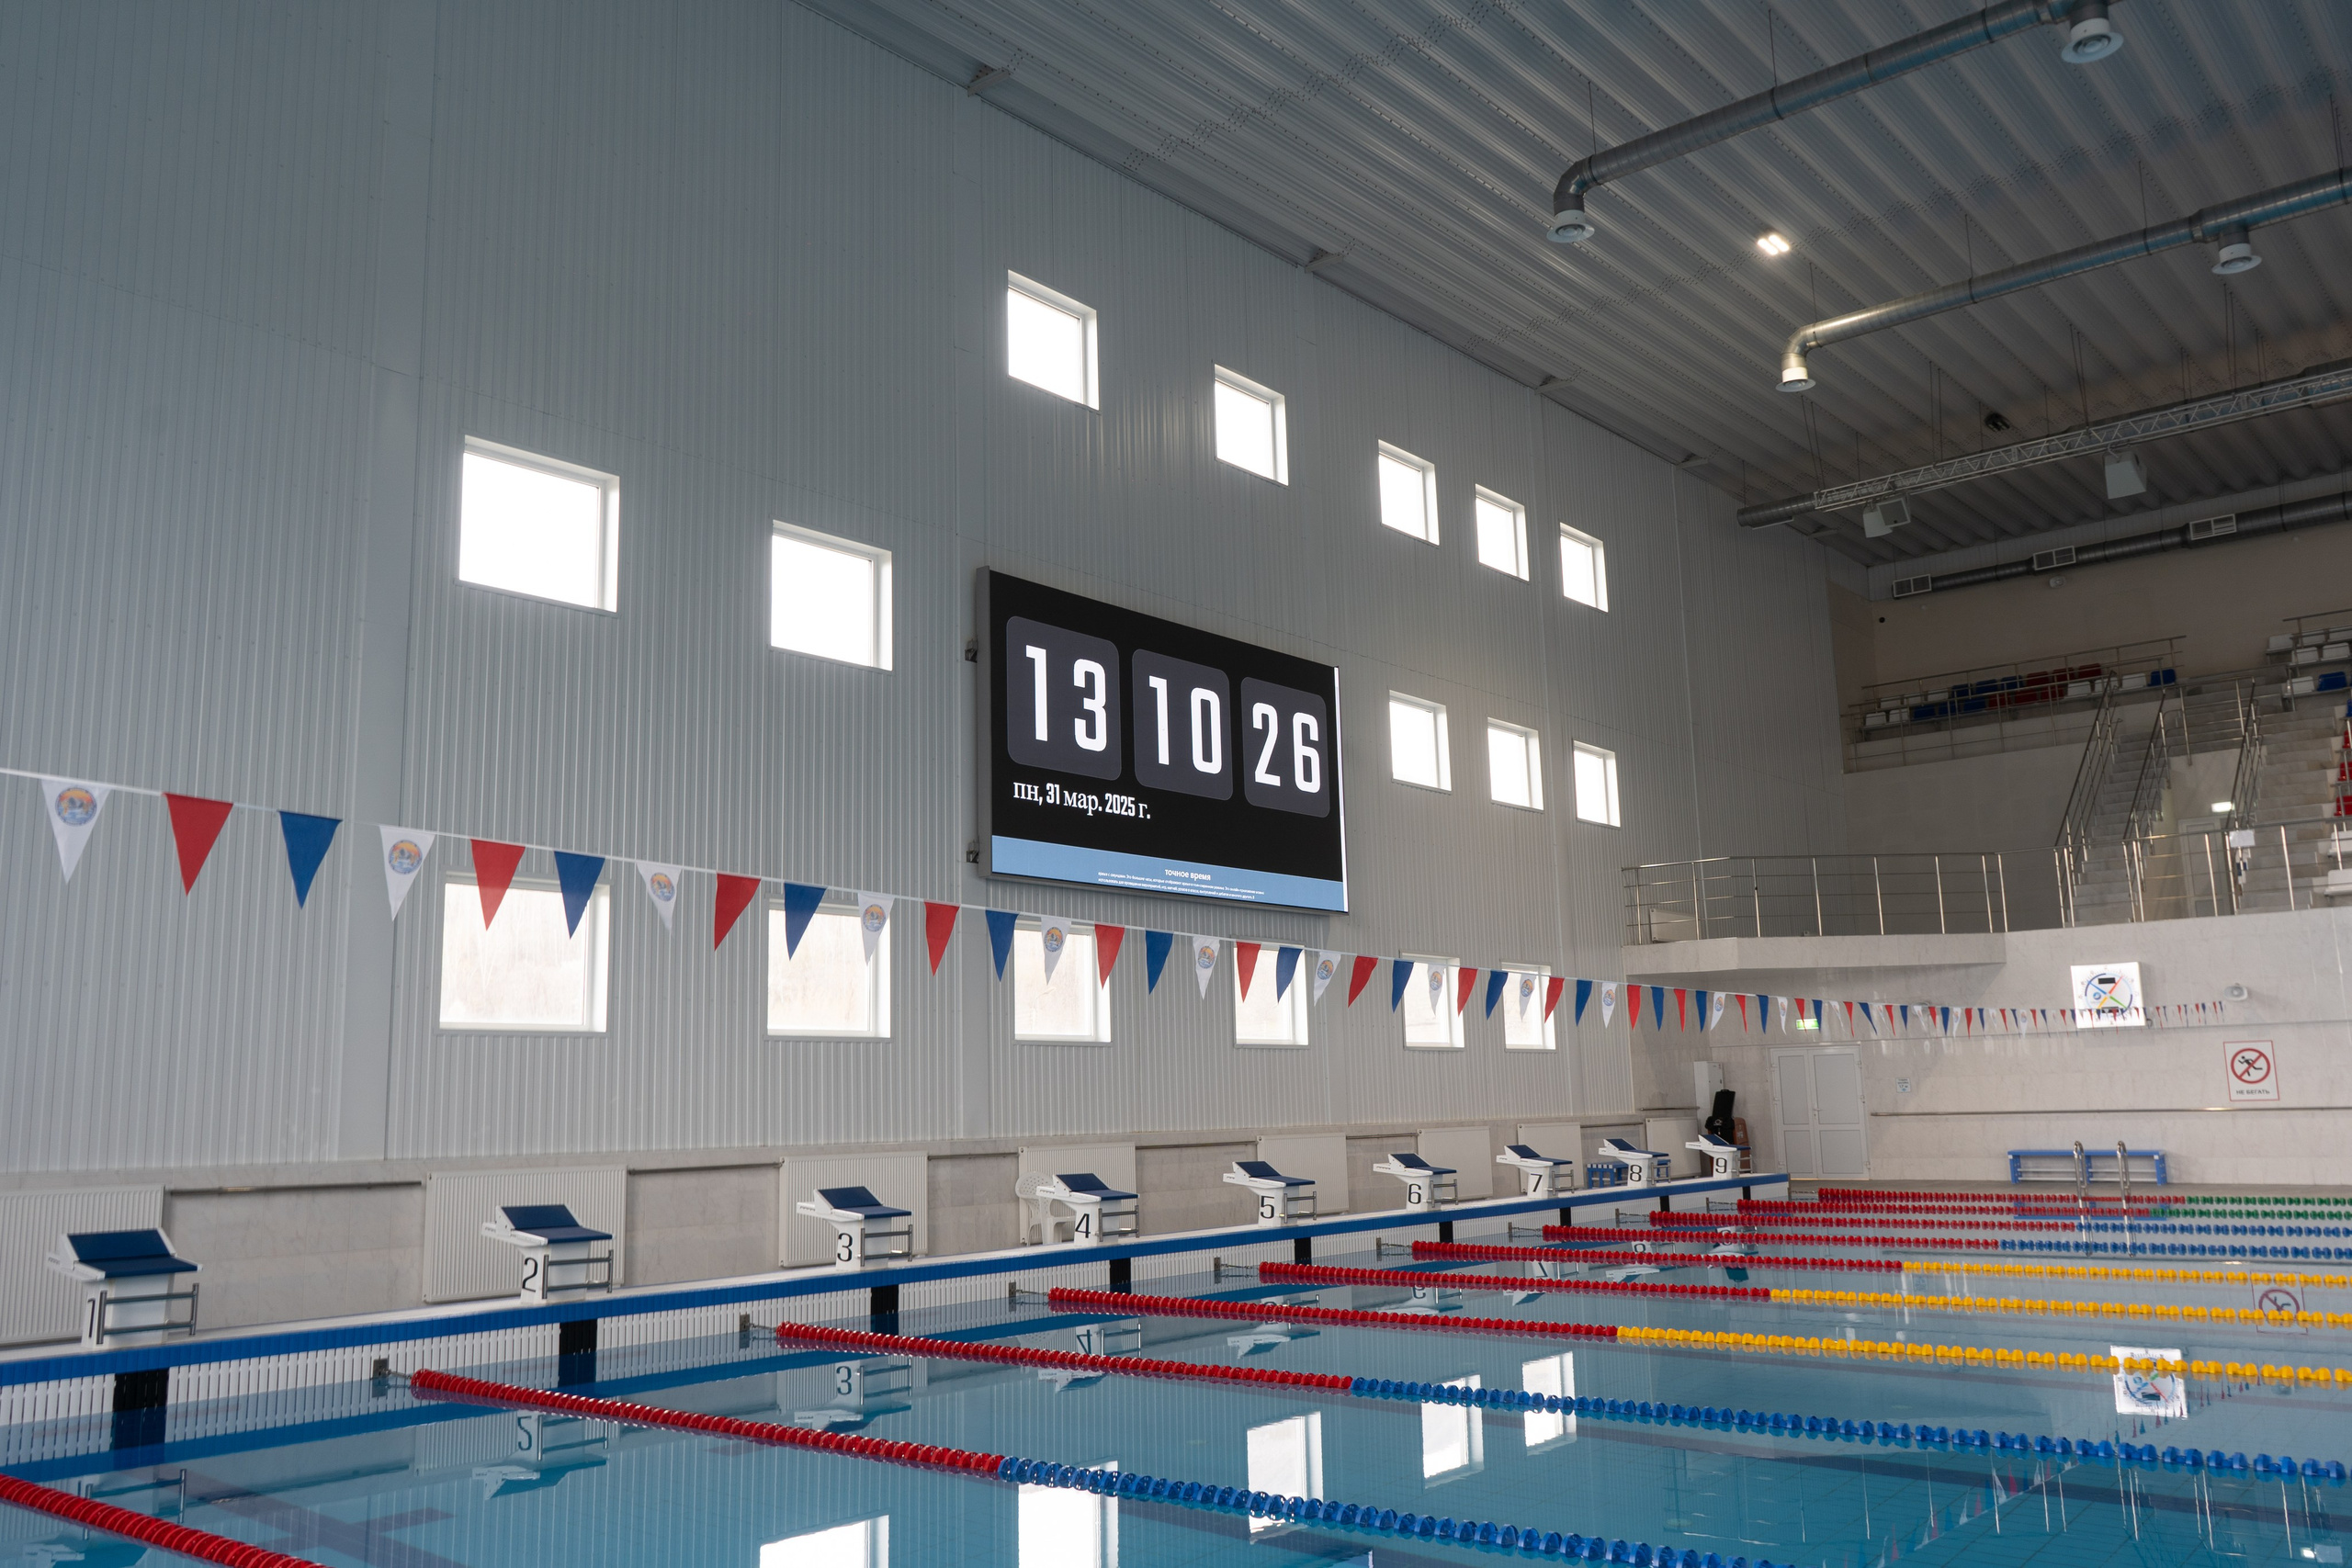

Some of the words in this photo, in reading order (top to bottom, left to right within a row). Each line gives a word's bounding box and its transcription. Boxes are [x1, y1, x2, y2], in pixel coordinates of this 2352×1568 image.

[1025, 644, 1107, 752] 13
[1148, 675, 1223, 774] 10
[1252, 702, 1321, 794] 26
[1012, 782, 1044, 807] пн,
[1046, 782, 1060, 806] 31
[1063, 790, 1102, 817] мар.
[1104, 792, 1136, 818] 2025
[1137, 803, 1151, 819] г.
[1164, 869, 1189, 878] точное
[1190, 872, 1212, 882] время
[1629, 1164, 1643, 1182] 8
[1715, 1157, 1728, 1174] 9
[1408, 1183, 1422, 1205] 6
[1530, 1173, 1544, 1192] 7
[1260, 1195, 1275, 1219] 5
[1074, 1213, 1091, 1239] 4
[837, 1233, 854, 1262] 3
[521, 1257, 538, 1292] 2
[87, 1298, 96, 1338] 1
